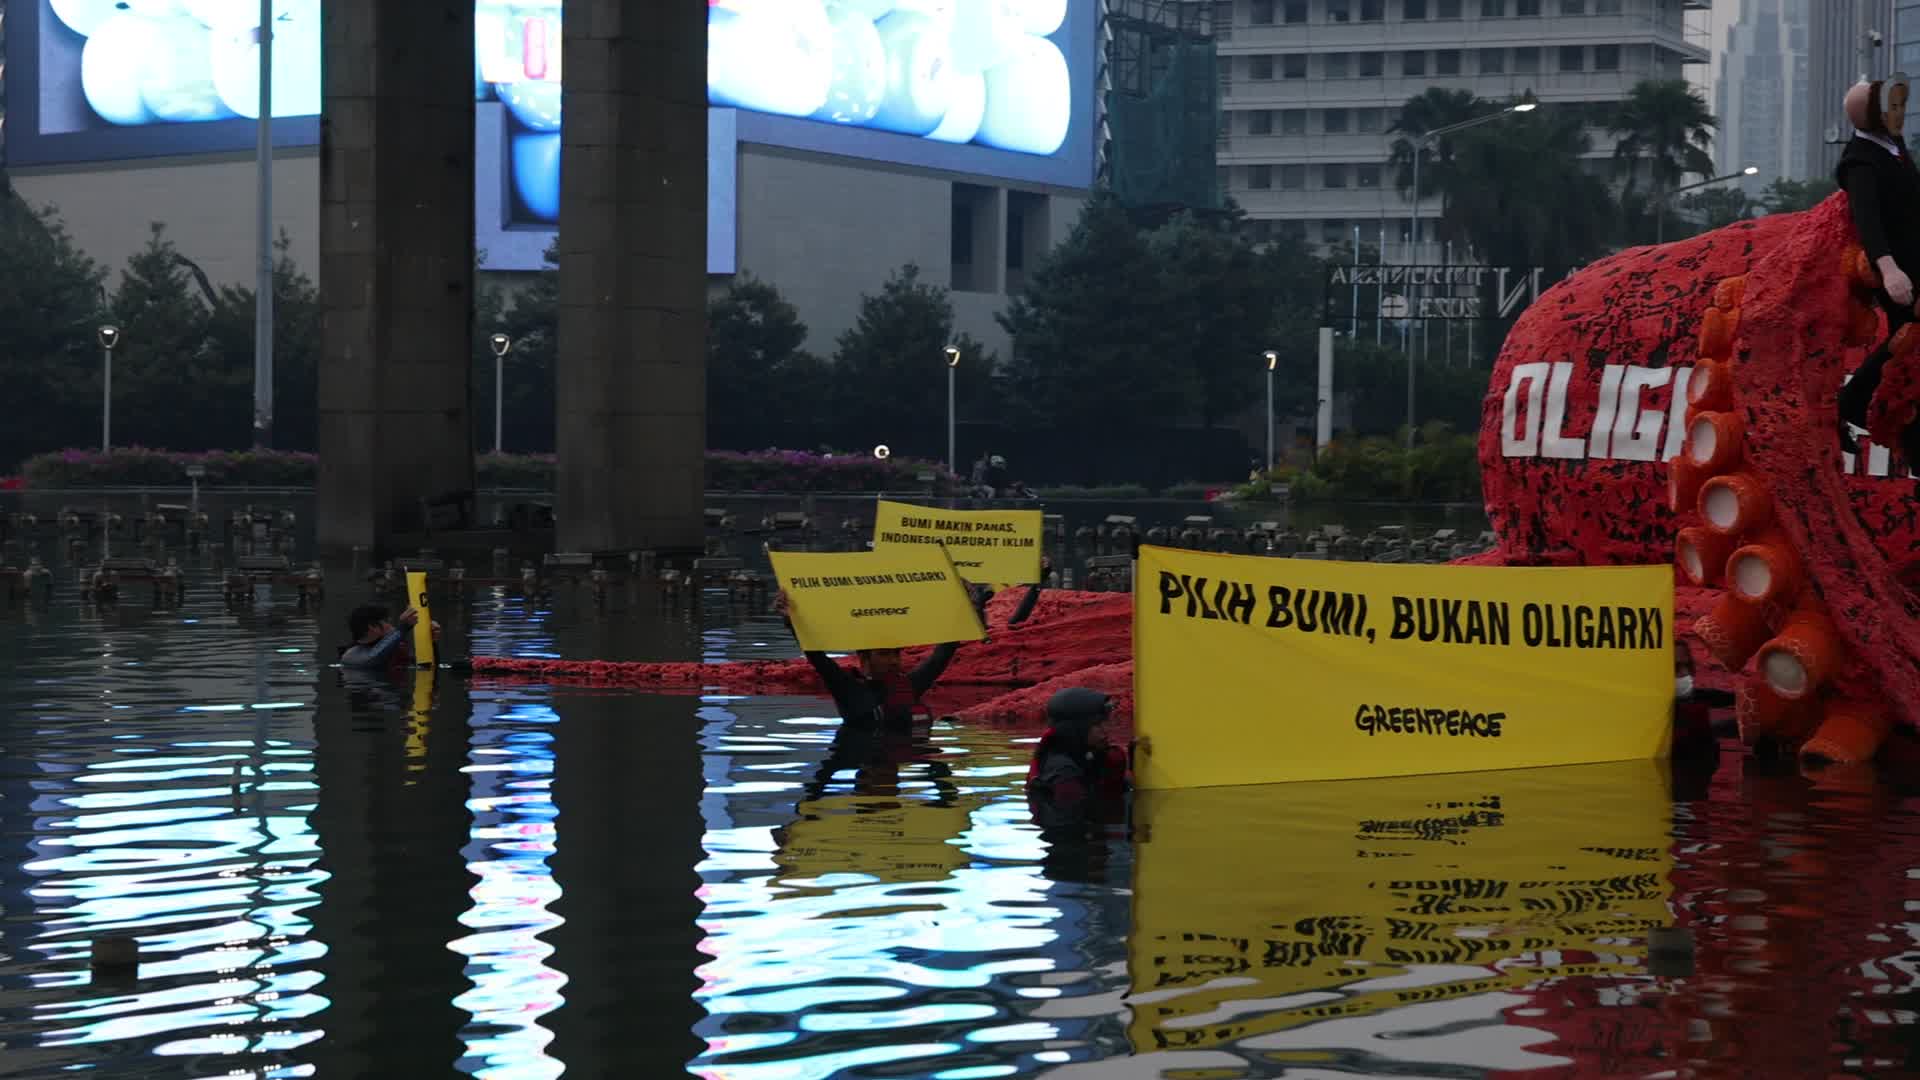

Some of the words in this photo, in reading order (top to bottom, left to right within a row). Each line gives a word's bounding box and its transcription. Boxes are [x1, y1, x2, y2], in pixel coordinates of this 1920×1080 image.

[902, 516, 932, 529] BUMI
[935, 519, 972, 532] MAKIN
[975, 522, 1017, 533] PANAS,
[946, 535, 999, 547] DARURAT
[1002, 537, 1035, 547] IKLIM
[790, 577, 821, 588] PILIH
[855, 574, 894, 586] BUKAN
[895, 571, 947, 584] OLIGARKI
[851, 606, 910, 617] GREENPEACE
[1159, 571, 1256, 625] PILIH
[1266, 585, 1376, 644] BUMI,
[1390, 596, 1510, 646] BUKAN
[1522, 602, 1664, 650] OLIGARKI
[1354, 703, 1506, 737] GREENPEACE
